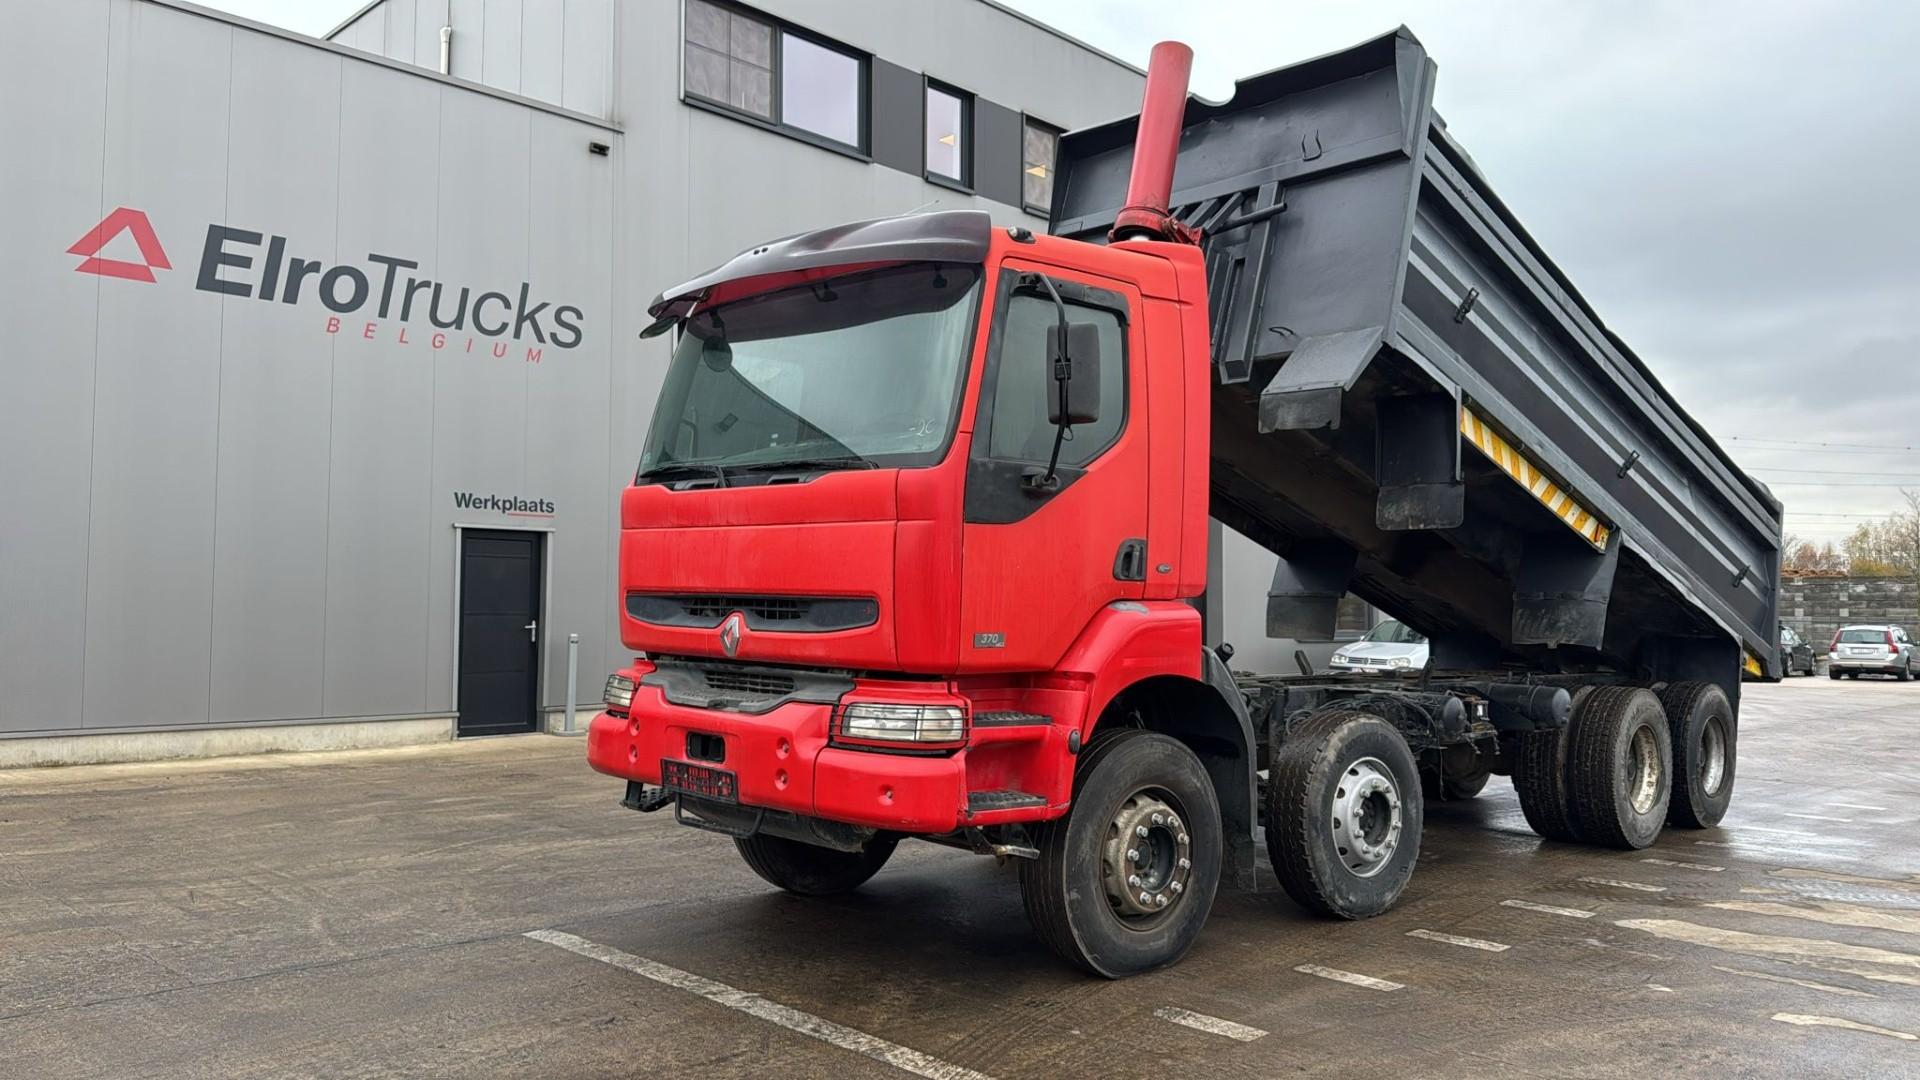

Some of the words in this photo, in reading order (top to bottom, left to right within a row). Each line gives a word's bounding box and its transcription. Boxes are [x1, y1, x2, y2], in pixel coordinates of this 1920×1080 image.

[195, 223, 585, 349] ElroTrucks
[326, 317, 543, 363] BELGIUM
[454, 491, 555, 514] Werkplaats
[980, 633, 999, 643] 370
